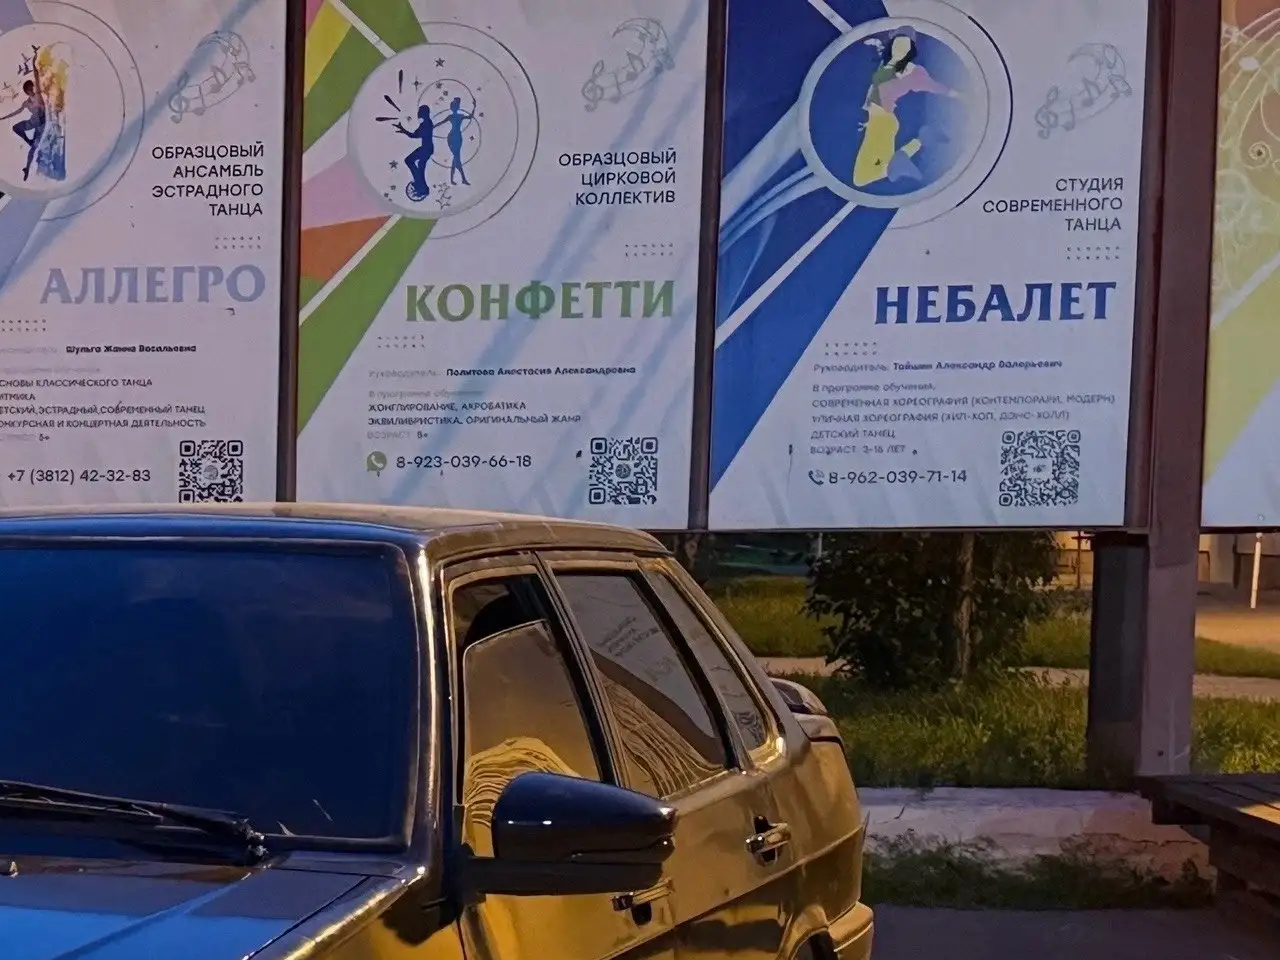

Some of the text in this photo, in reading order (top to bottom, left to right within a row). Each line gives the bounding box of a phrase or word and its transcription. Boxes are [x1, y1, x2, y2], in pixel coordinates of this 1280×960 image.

[152, 141, 264, 160] ОБРАЗЦОВЫЙ
[558, 148, 677, 167] ОБРАЗЦОВЫЙ
[173, 164, 263, 178] АНСАМБЛЬ
[581, 168, 675, 187] ЦИРКОВОЙ
[152, 183, 264, 198] ЭСТРАДНОГО
[1055, 177, 1124, 193] СТУДИЯ
[575, 191, 675, 205] КОЛЛЕКТИВ
[982, 197, 1123, 213] СОВРЕМЕННОГО
[209, 203, 263, 217] ТАНЦА
[1065, 217, 1122, 233] ТАНЦА
[40, 264, 266, 304] АЛЛЕГРО
[406, 280, 674, 323] КОНФЕТТИ
[874, 281, 1117, 325] НЕБАЛЕТ
[396, 455, 532, 469] 8-923-039-66-18
[7, 469, 151, 485] +7 (3812) 42-32-83
[828, 470, 968, 484] 8-962-039-71-14
